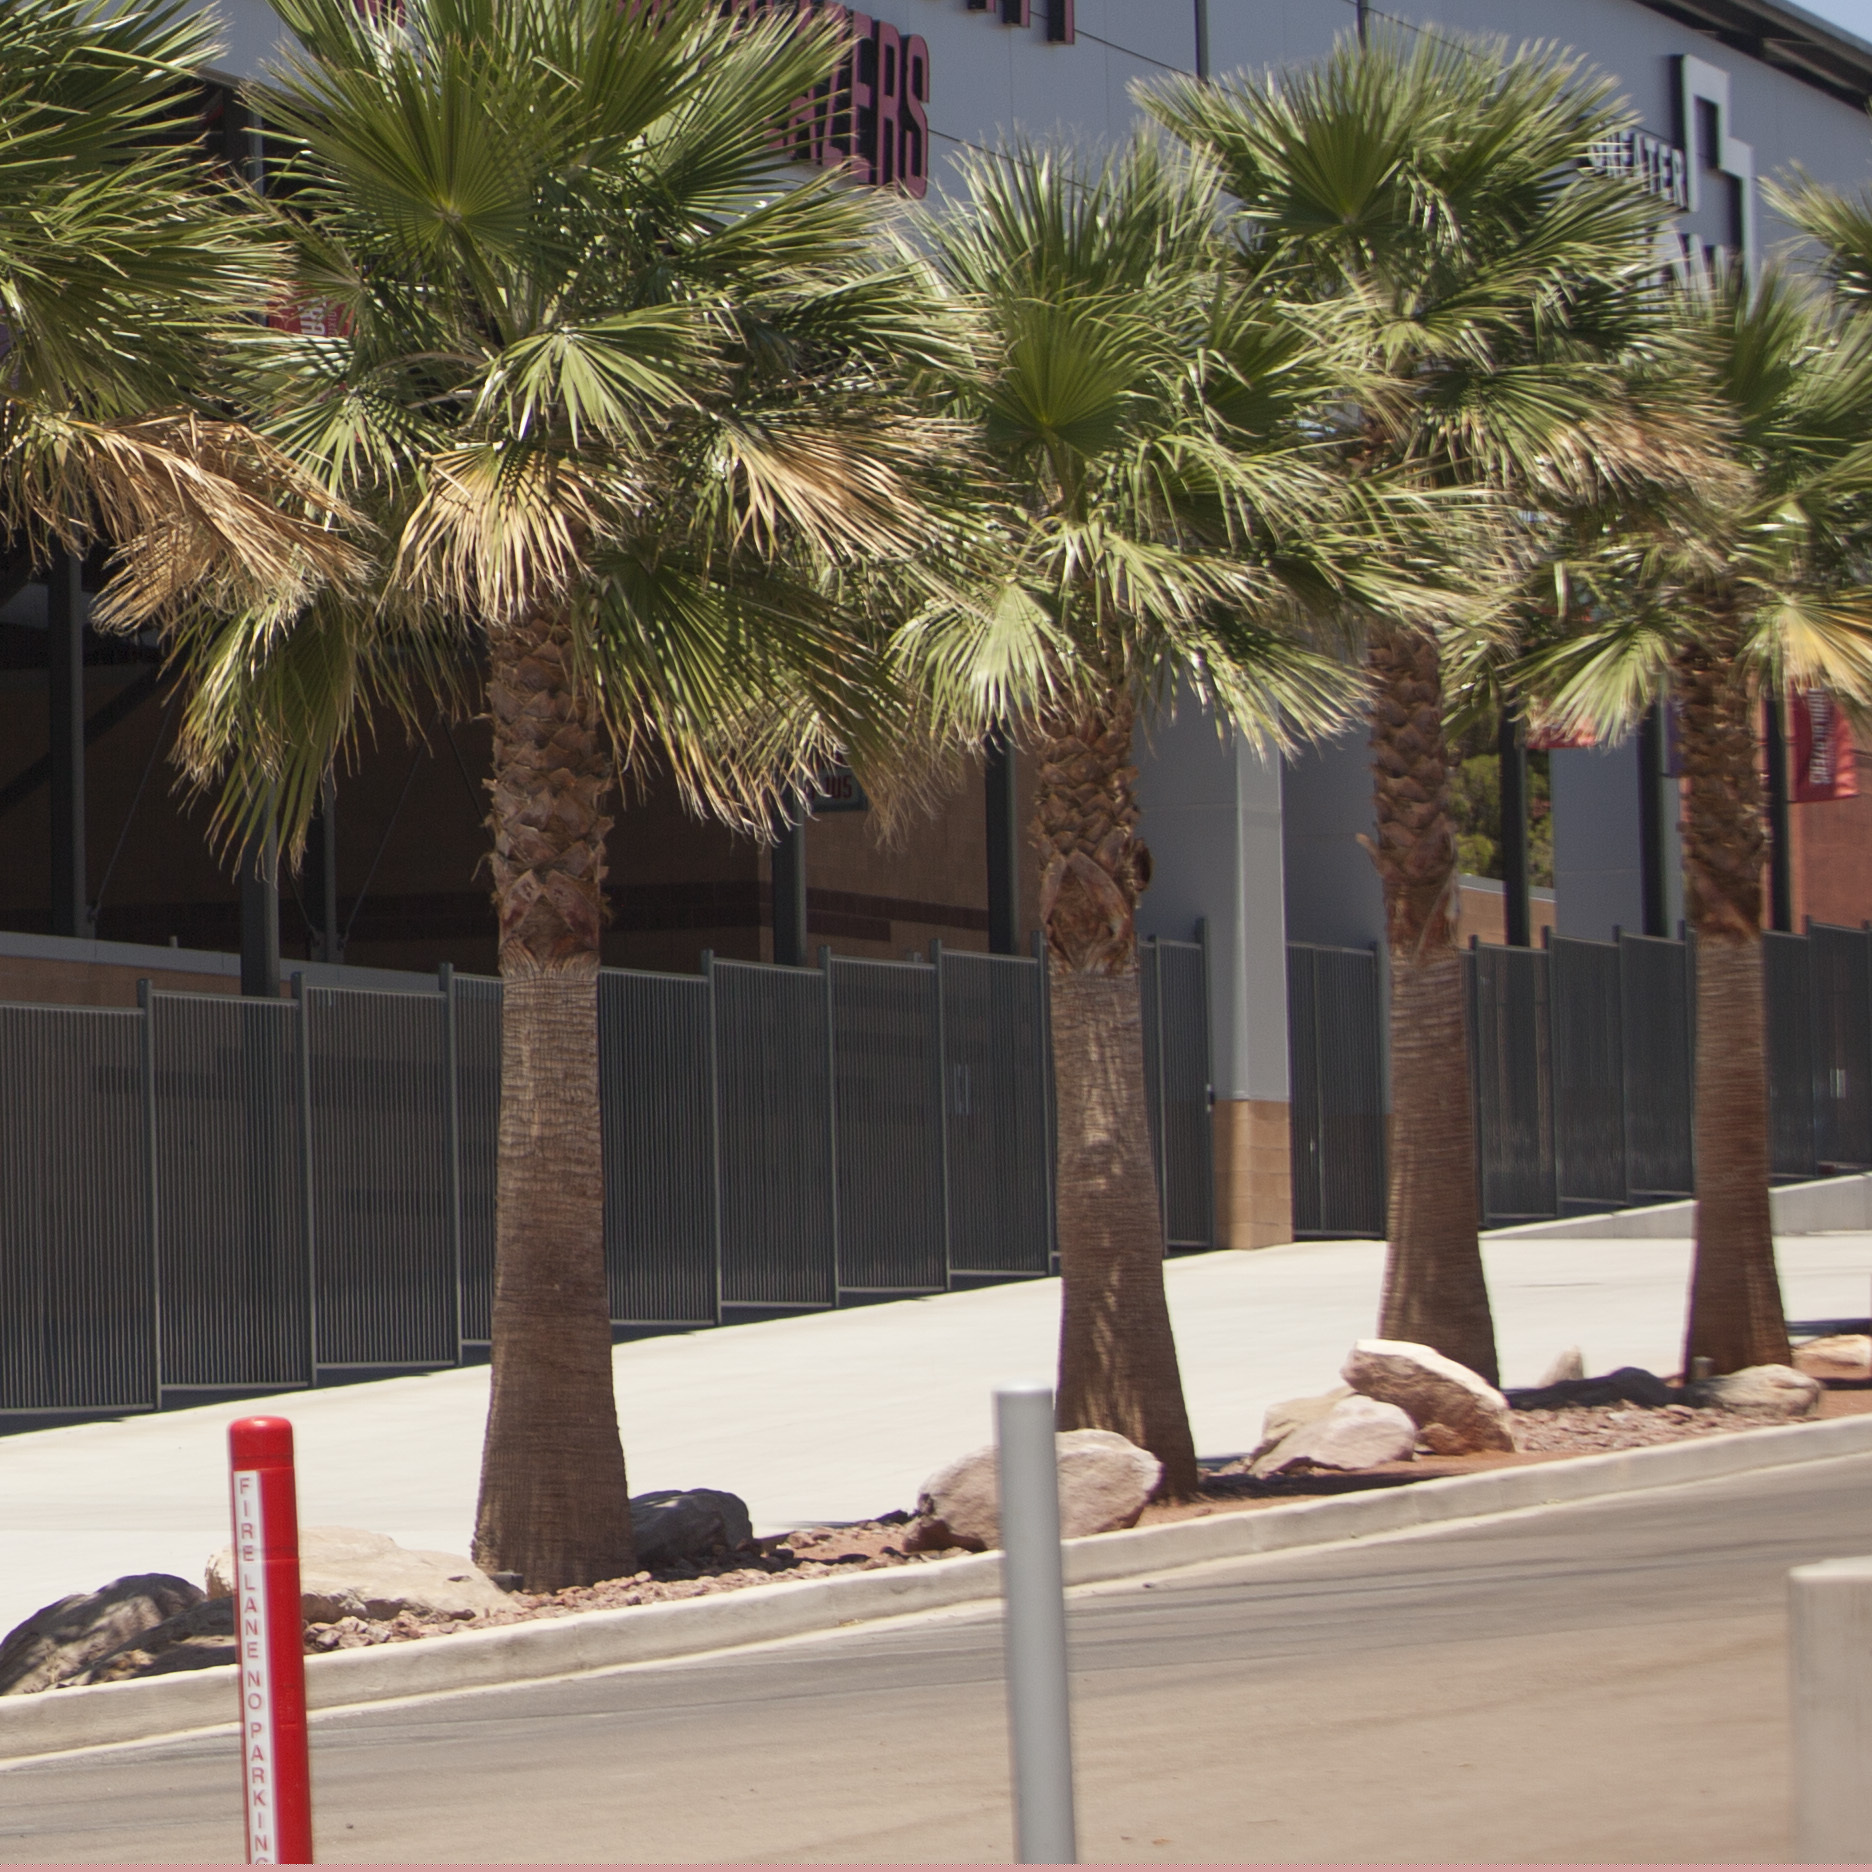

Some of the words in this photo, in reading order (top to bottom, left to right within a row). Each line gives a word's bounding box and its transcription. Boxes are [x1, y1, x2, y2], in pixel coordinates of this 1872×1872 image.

[239, 1477, 255, 1562] FIRE
[243, 1572, 259, 1659] LANE
[247, 1671, 263, 1711] NO
